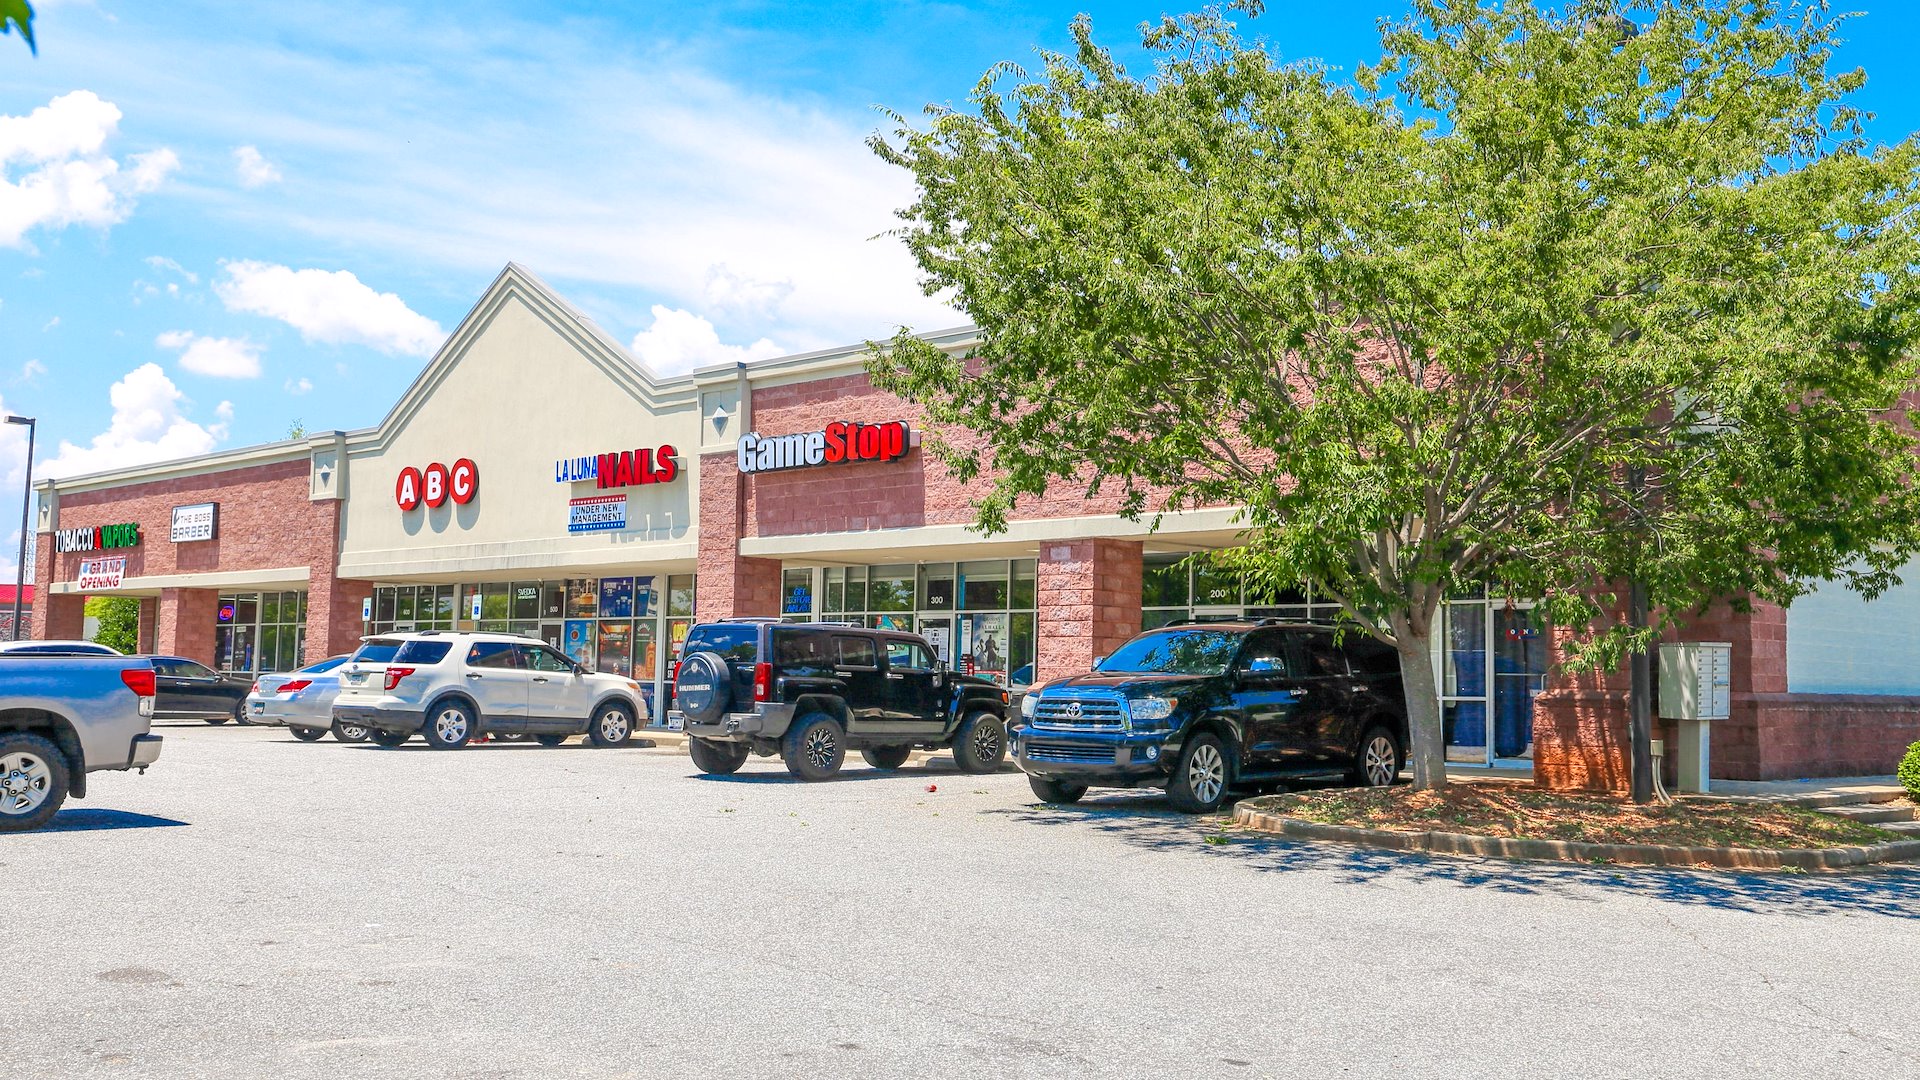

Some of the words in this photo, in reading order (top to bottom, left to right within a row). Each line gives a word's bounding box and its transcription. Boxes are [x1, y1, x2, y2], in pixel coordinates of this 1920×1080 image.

[737, 421, 903, 473] GameStop
[556, 460, 569, 482] LA
[571, 456, 597, 480] LUNA
[597, 445, 676, 489] NAILS
[575, 504, 600, 514] UNDER
[602, 503, 619, 513] NEW
[180, 514, 192, 524] THE
[194, 512, 211, 522] BOSS
[571, 512, 622, 524] MANAGEMENT
[54, 527, 94, 553] TOBACCO
[101, 522, 137, 549] VAPORS
[172, 524, 210, 540] BARBER
[89, 560, 121, 575] GRAND
[80, 575, 120, 590] OPENING
[930, 596, 944, 604] 300
[1210, 589, 1226, 598] 200
[679, 684, 711, 692] HUMMER
